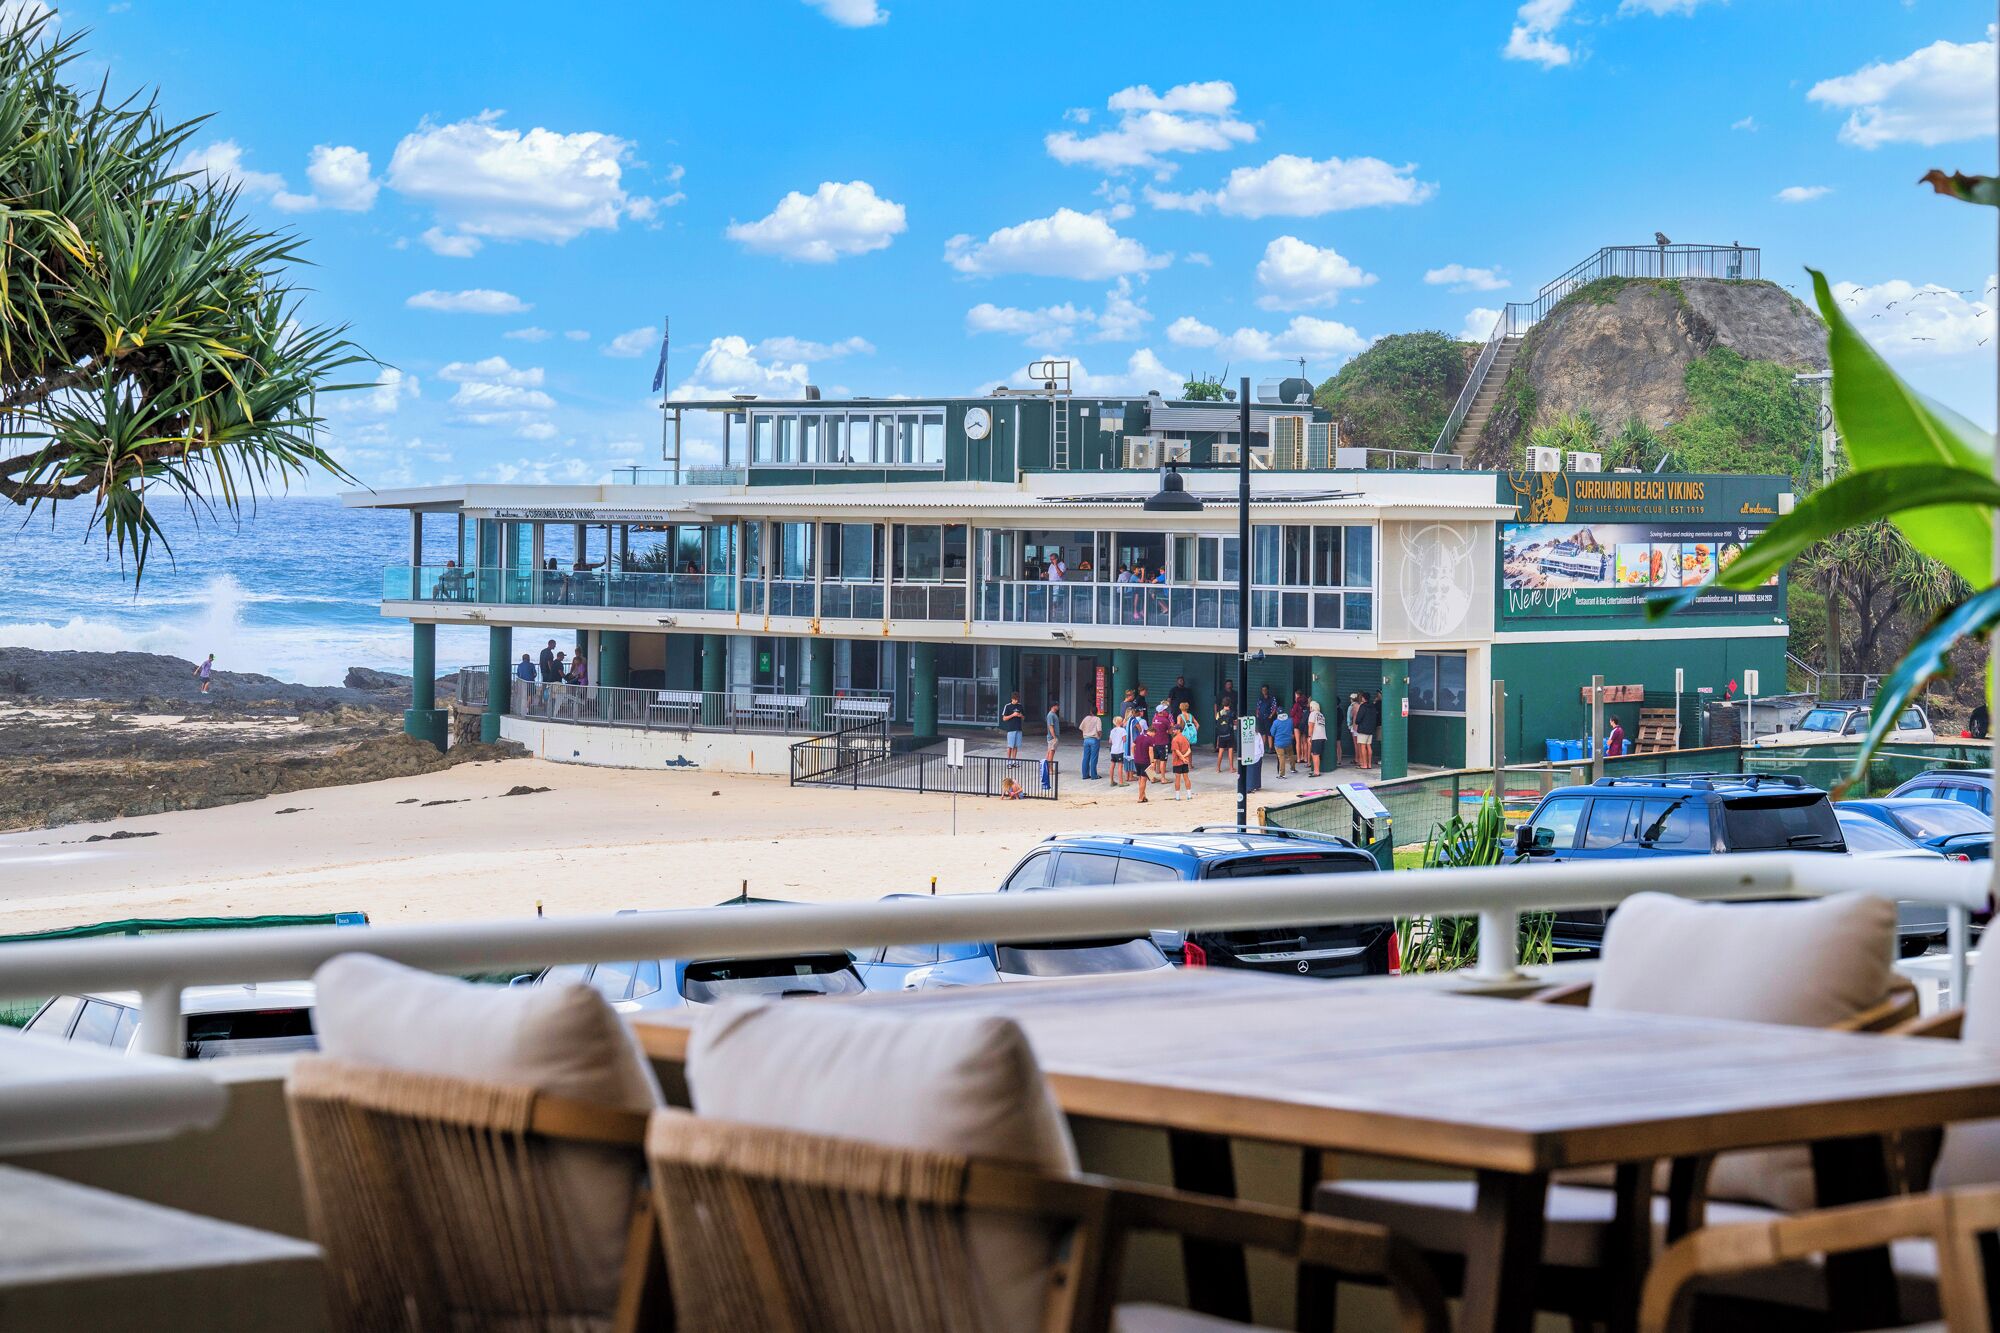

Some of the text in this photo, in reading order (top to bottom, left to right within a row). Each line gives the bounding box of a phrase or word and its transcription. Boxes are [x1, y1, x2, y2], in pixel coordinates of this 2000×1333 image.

[1574, 480, 1705, 501] CURRUMBIN BEACH VIKINGS
[1574, 505, 1705, 514] SURF LIFE SAVING CLUB EST 1919
[529, 510, 558, 519] CURRUMBIN
[558, 510, 575, 519] BEACH
[576, 511, 596, 520] VIKINGS
[1509, 579, 1577, 614] We're Open
[1575, 597, 1596, 605] Restaurant
[1606, 597, 1633, 605] Entertainment
[1738, 594, 1756, 602] BOOKINGS
[1242, 719, 1255, 730] 3P
